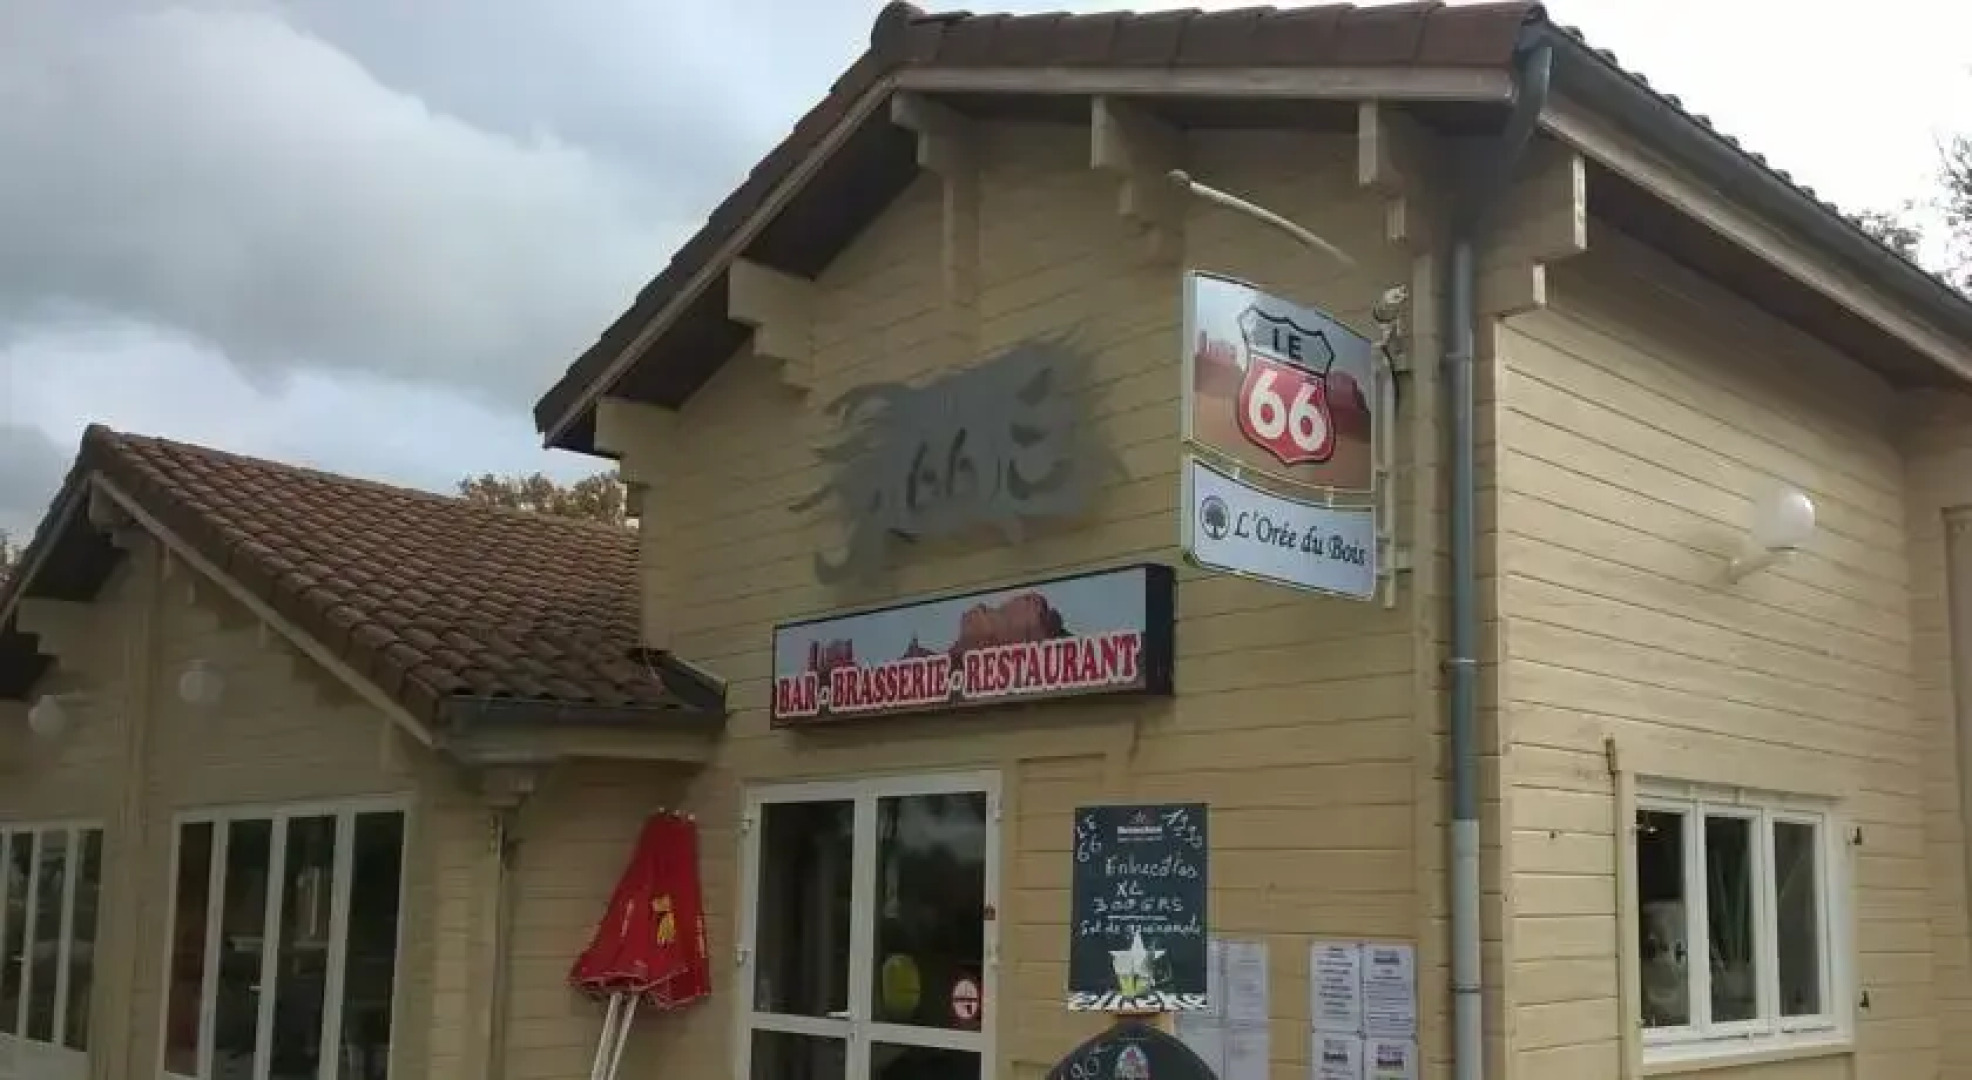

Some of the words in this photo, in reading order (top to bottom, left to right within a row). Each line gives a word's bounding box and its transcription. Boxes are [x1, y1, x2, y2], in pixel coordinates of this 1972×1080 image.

[1250, 368, 1327, 452] 66
[1235, 510, 1296, 548] L'Orée
[1301, 525, 1323, 555] du
[1328, 534, 1365, 567] Bois
[778, 672, 818, 716] BAR
[831, 656, 949, 711] BRASSERIE
[965, 630, 1140, 696] RESTAURANT
